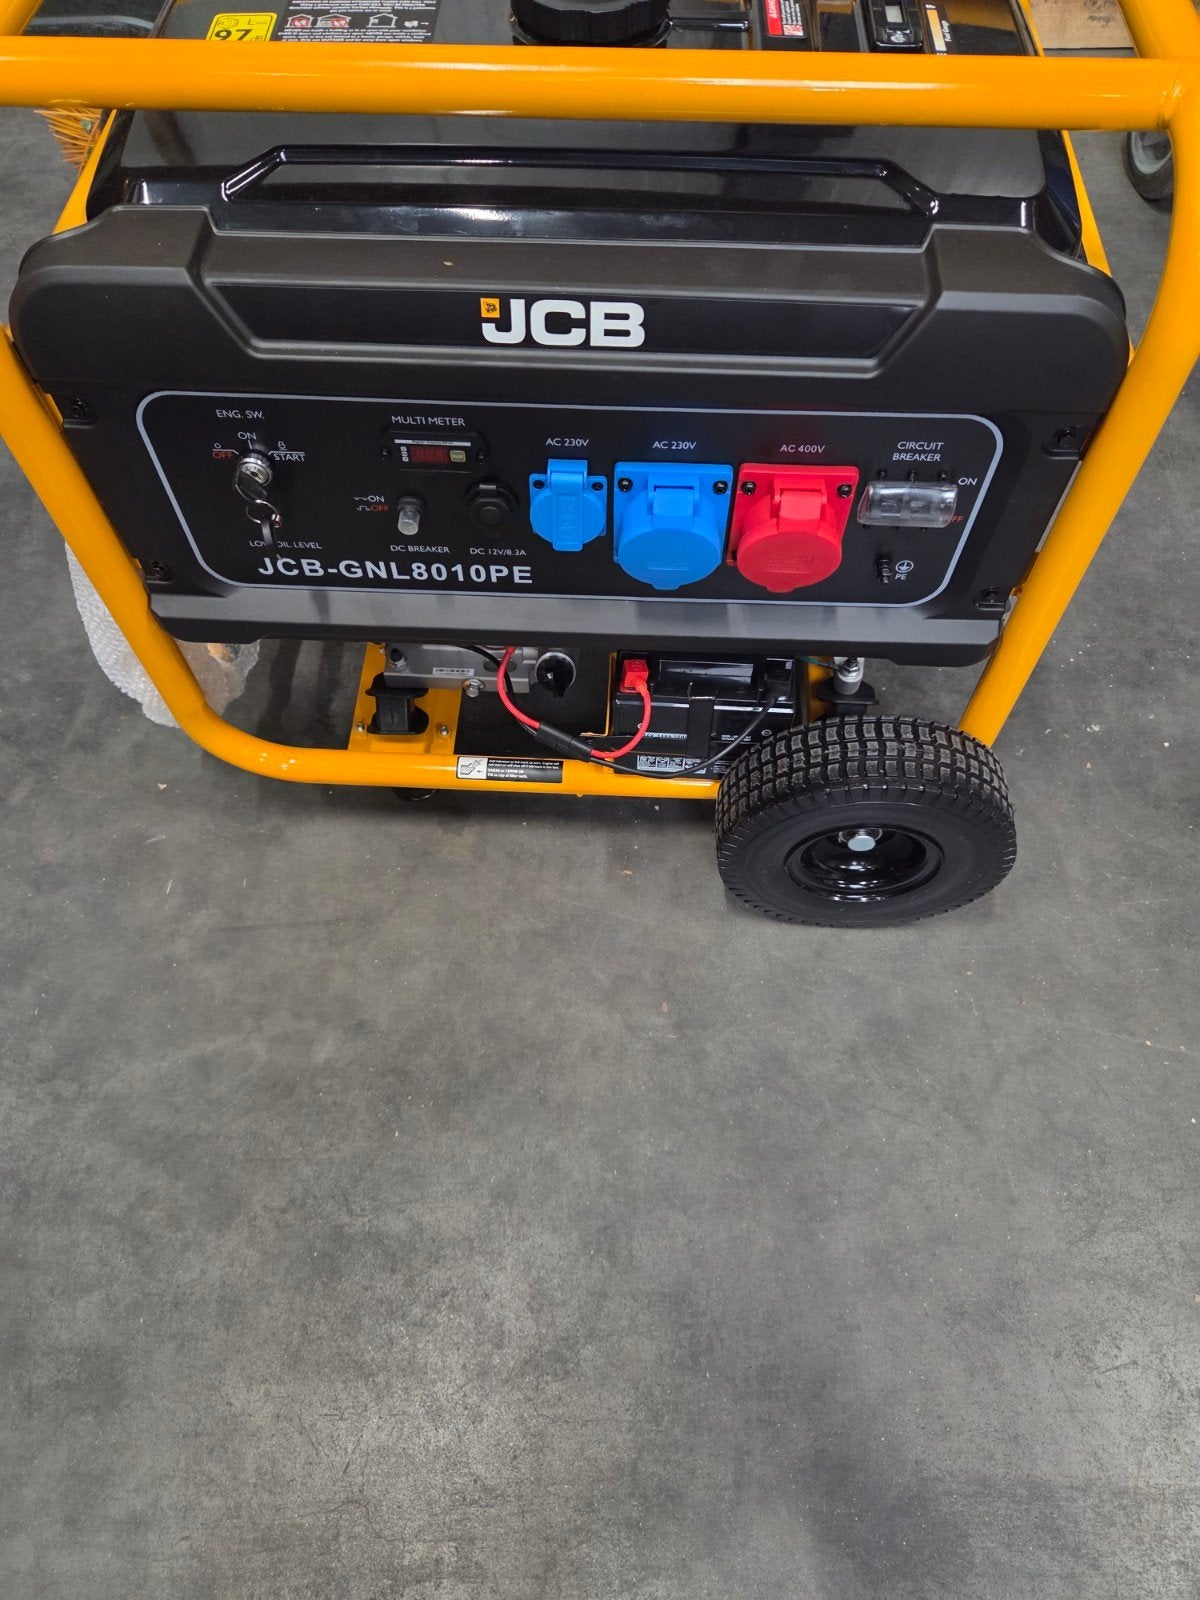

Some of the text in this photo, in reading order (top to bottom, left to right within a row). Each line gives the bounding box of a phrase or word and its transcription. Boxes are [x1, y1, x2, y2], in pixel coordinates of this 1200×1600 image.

[481, 298, 646, 348] JCB
[216, 409, 265, 419] ENG. SW.
[391, 415, 466, 427] MULTI METER
[237, 431, 257, 440] ON
[545, 438, 590, 447] AC 230V
[652, 441, 697, 450] AC 230V
[897, 441, 945, 451] CIRCUIT
[780, 444, 826, 454] AC 400V
[212, 452, 233, 460] OFF
[273, 453, 306, 462] START
[892, 452, 941, 462] BREAKER
[958, 477, 978, 486] ON
[368, 495, 385, 503] ON
[371, 504, 390, 512] OFF
[294, 541, 322, 549] LEVEL
[390, 544, 450, 554] DC BREAKER
[470, 547, 527, 556] DC 12V/8.3A
[258, 556, 533, 583] JCB-GNL8010PE
